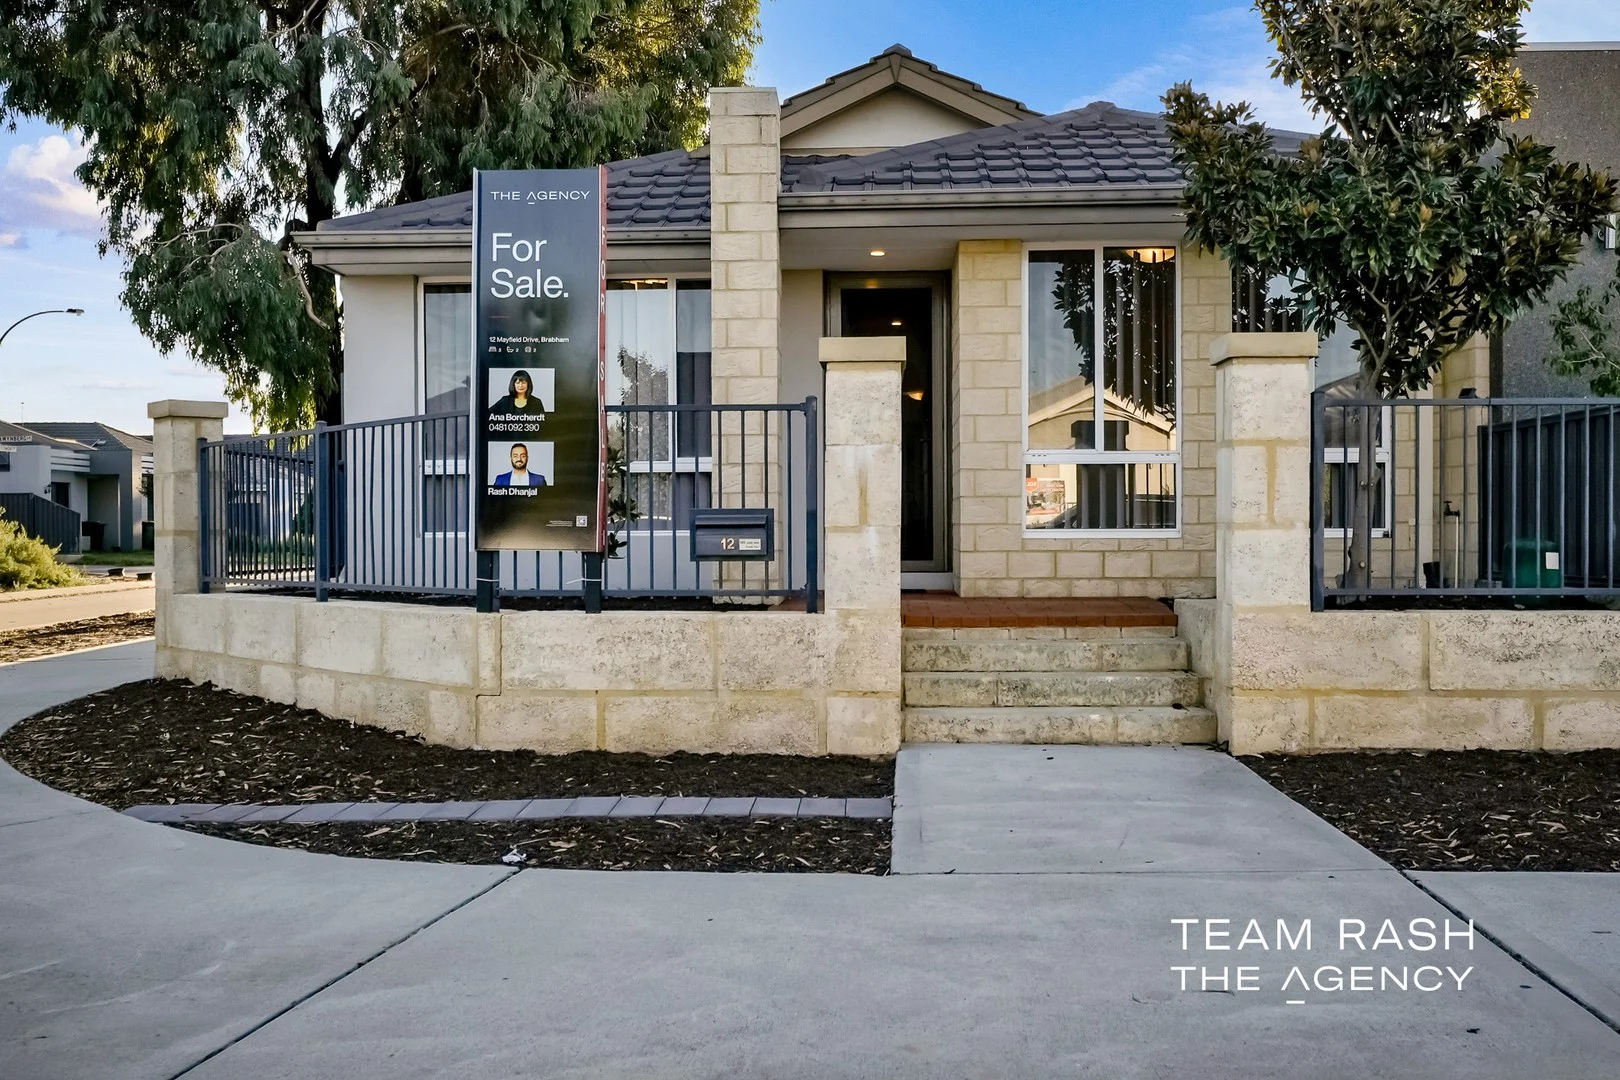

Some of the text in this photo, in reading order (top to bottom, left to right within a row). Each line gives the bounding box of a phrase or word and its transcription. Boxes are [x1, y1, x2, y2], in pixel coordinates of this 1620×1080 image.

[491, 190, 590, 204] THE AGENCY
[492, 232, 548, 262] For
[490, 267, 569, 299] Sale.
[496, 336, 522, 344] Mayfield
[522, 336, 540, 344] Drive,
[488, 413, 504, 421] Ana
[488, 423, 540, 432] 0481 092 390
[488, 487, 538, 497] Rash Dhanjal
[720, 537, 735, 550] 12
